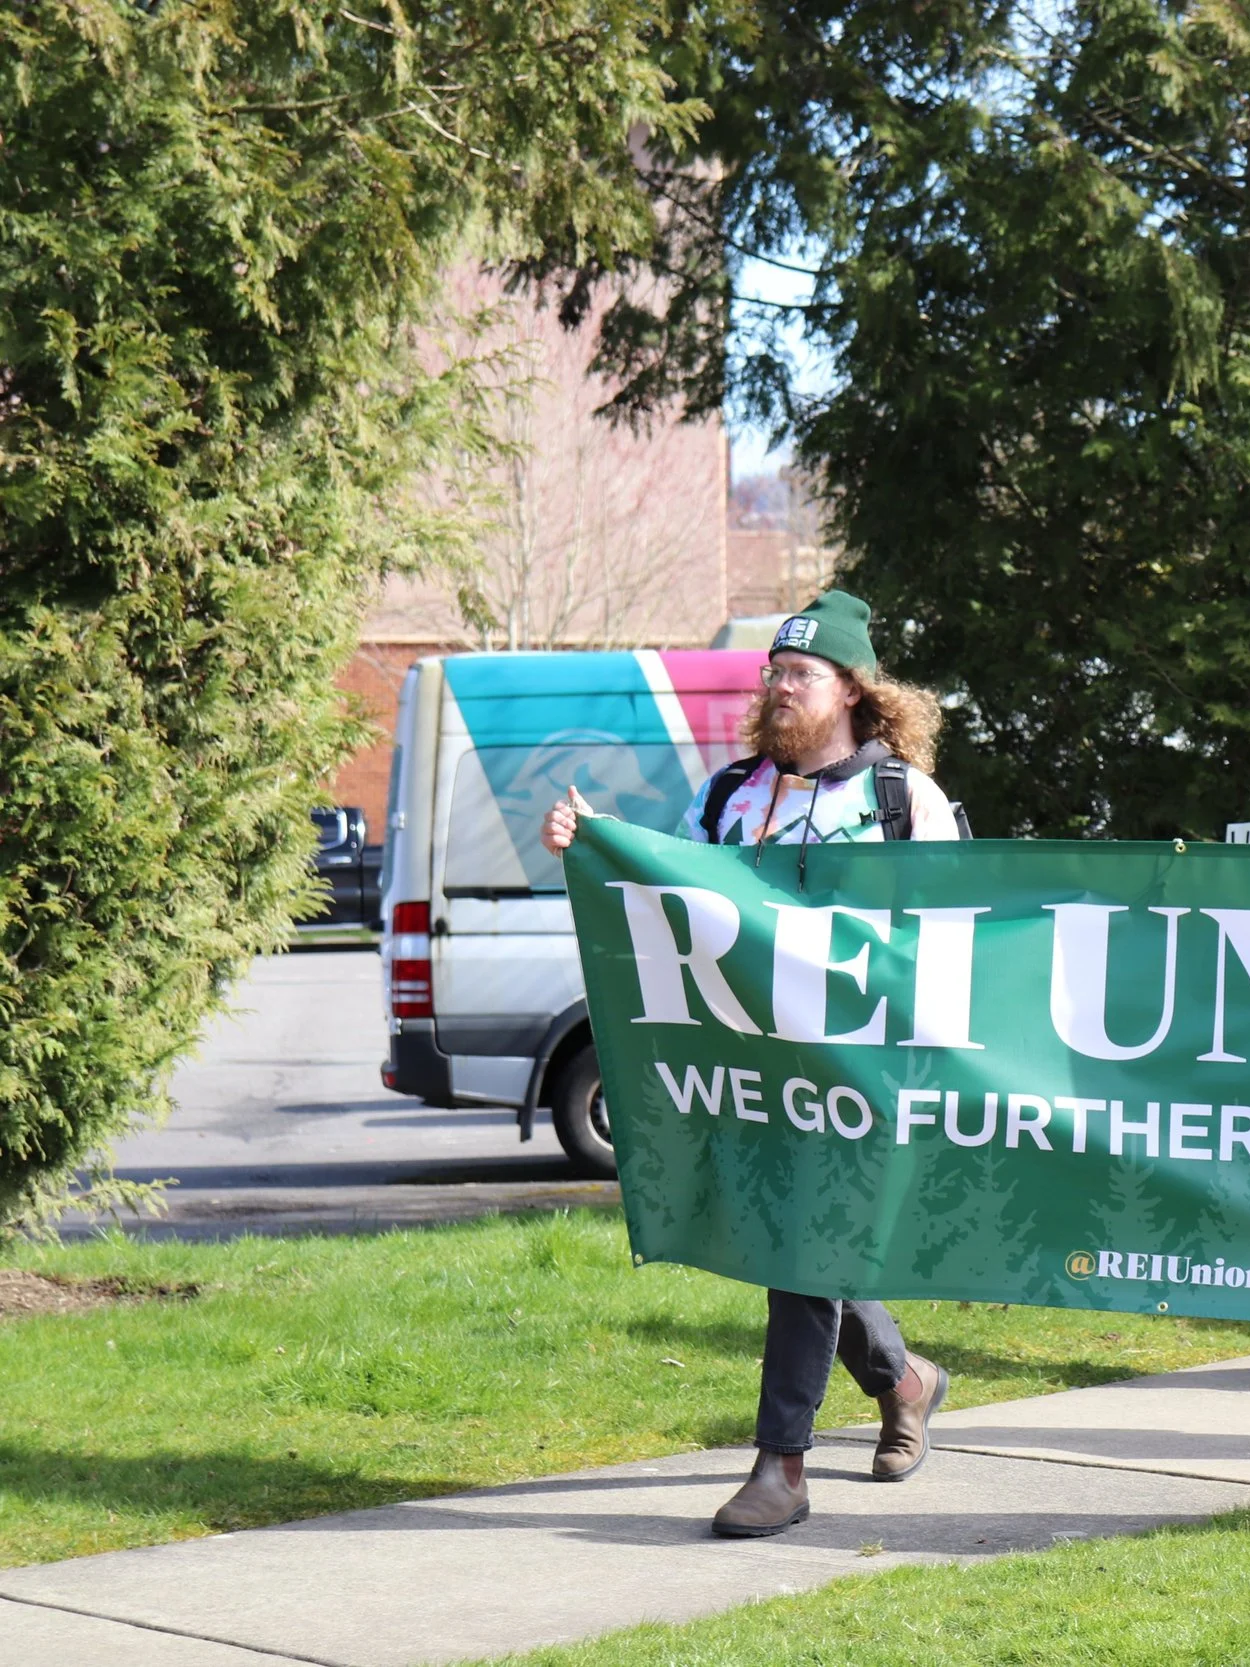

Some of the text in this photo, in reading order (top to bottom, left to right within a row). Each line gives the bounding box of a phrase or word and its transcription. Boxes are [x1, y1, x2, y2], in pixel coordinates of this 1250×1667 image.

[773, 618, 819, 641] REI
[604, 880, 991, 1052] REI
[654, 1062, 769, 1124] WE
[782, 1077, 873, 1140] GO
